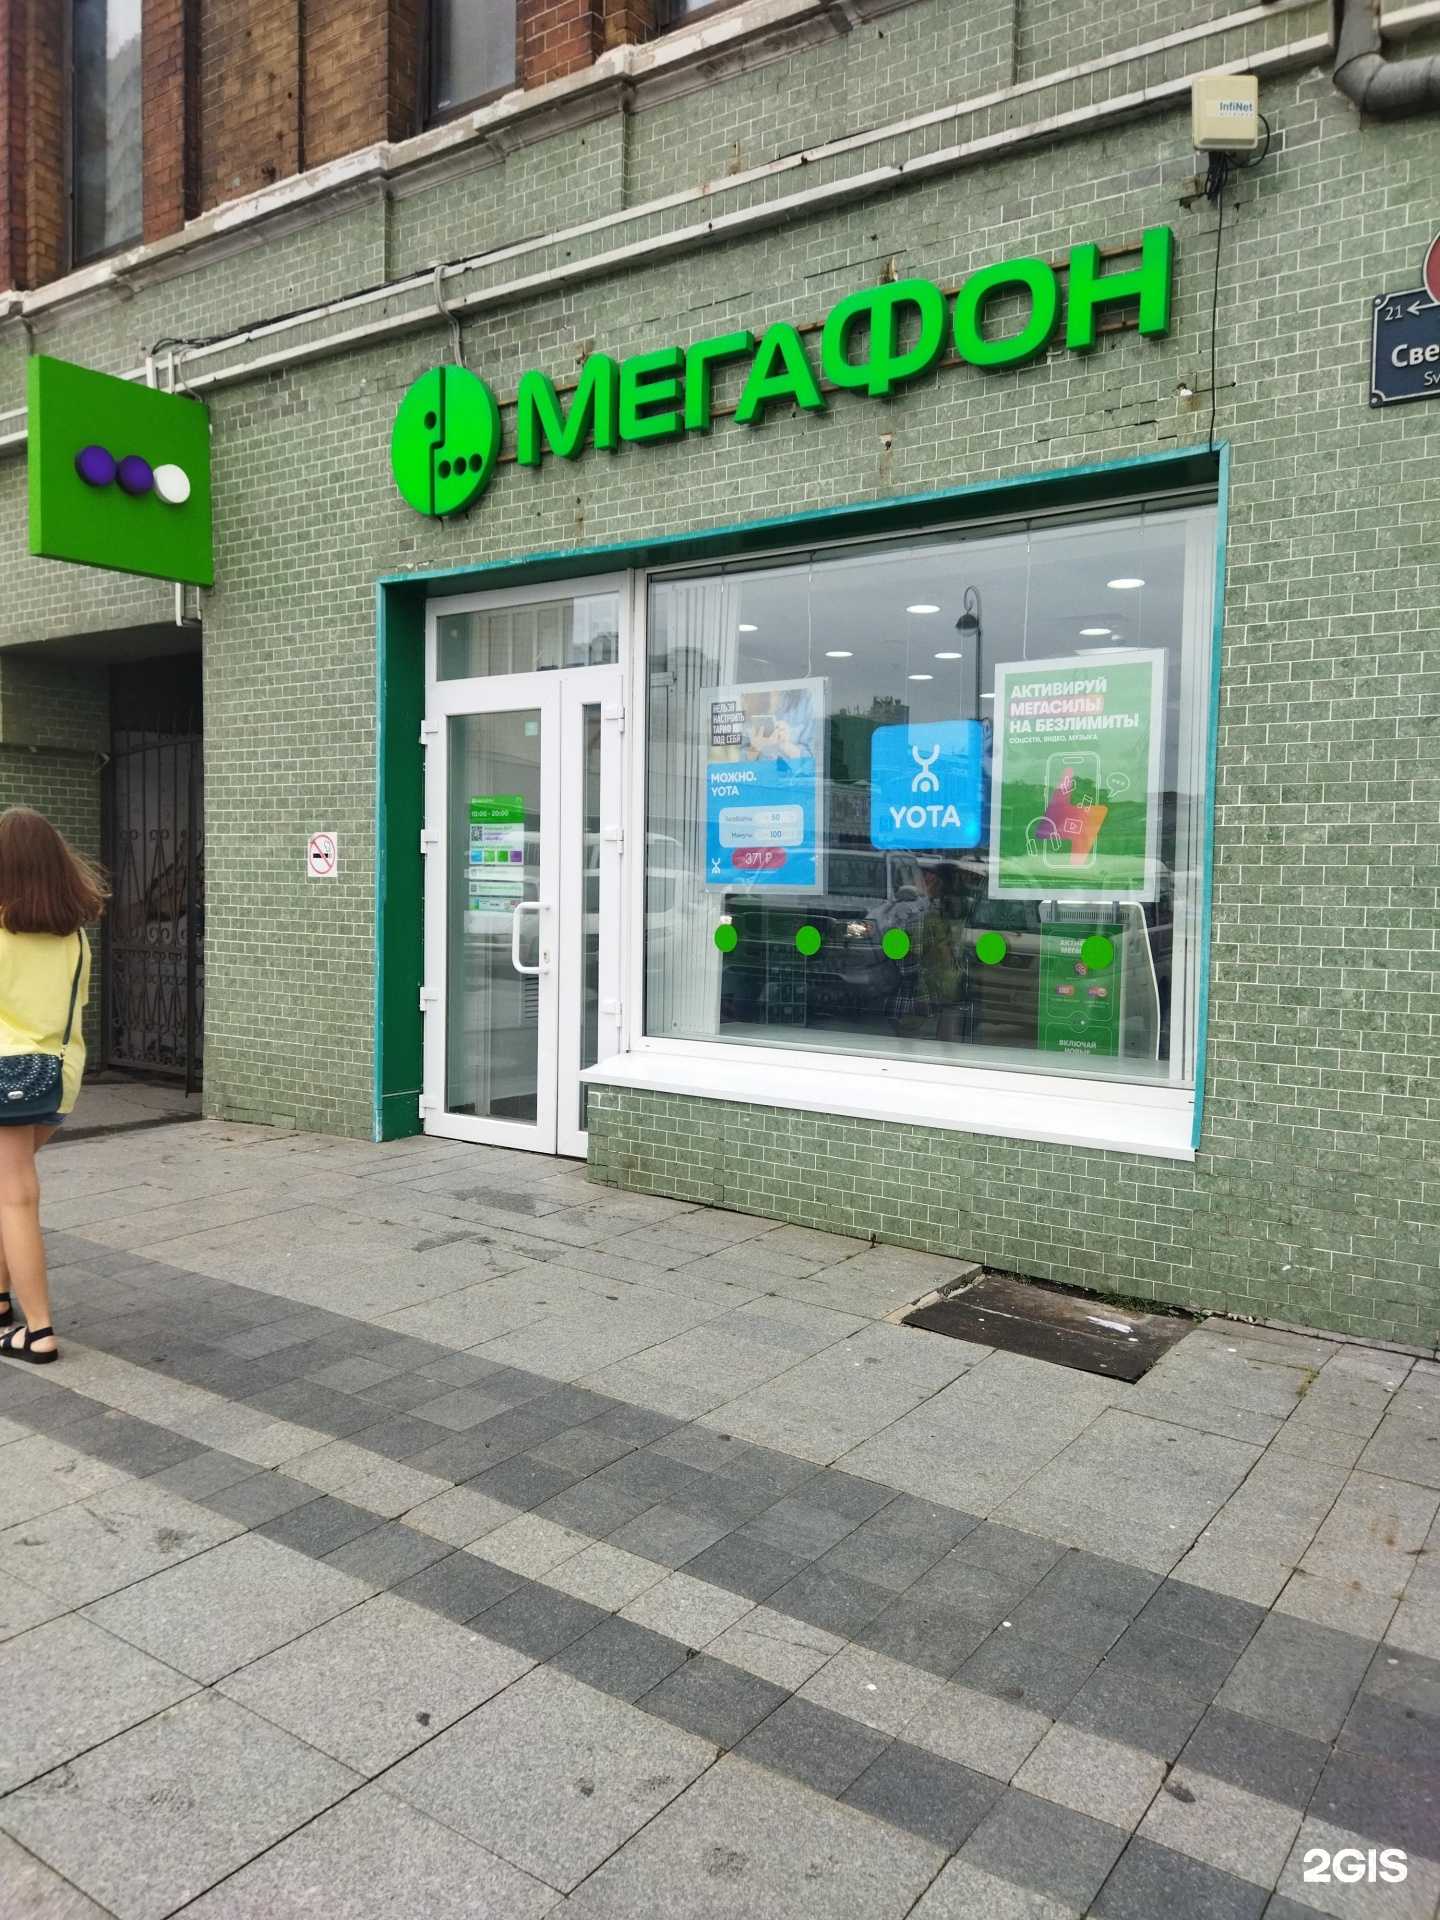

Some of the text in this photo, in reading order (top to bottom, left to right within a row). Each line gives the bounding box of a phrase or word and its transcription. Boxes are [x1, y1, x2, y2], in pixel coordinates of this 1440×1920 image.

[1384, 304, 1403, 321] 21
[517, 225, 1174, 468] МЕГАФОН
[1012, 677, 1107, 698] АКТИВИРУЙ
[1011, 698, 1103, 716] МЕГАСИЛЫ
[1010, 713, 1138, 733] НА БЕЗЛИМИТЫ
[711, 770, 757, 784] МОЖНО.
[711, 784, 740, 798] YOTA
[889, 804, 961, 829] YOTA
